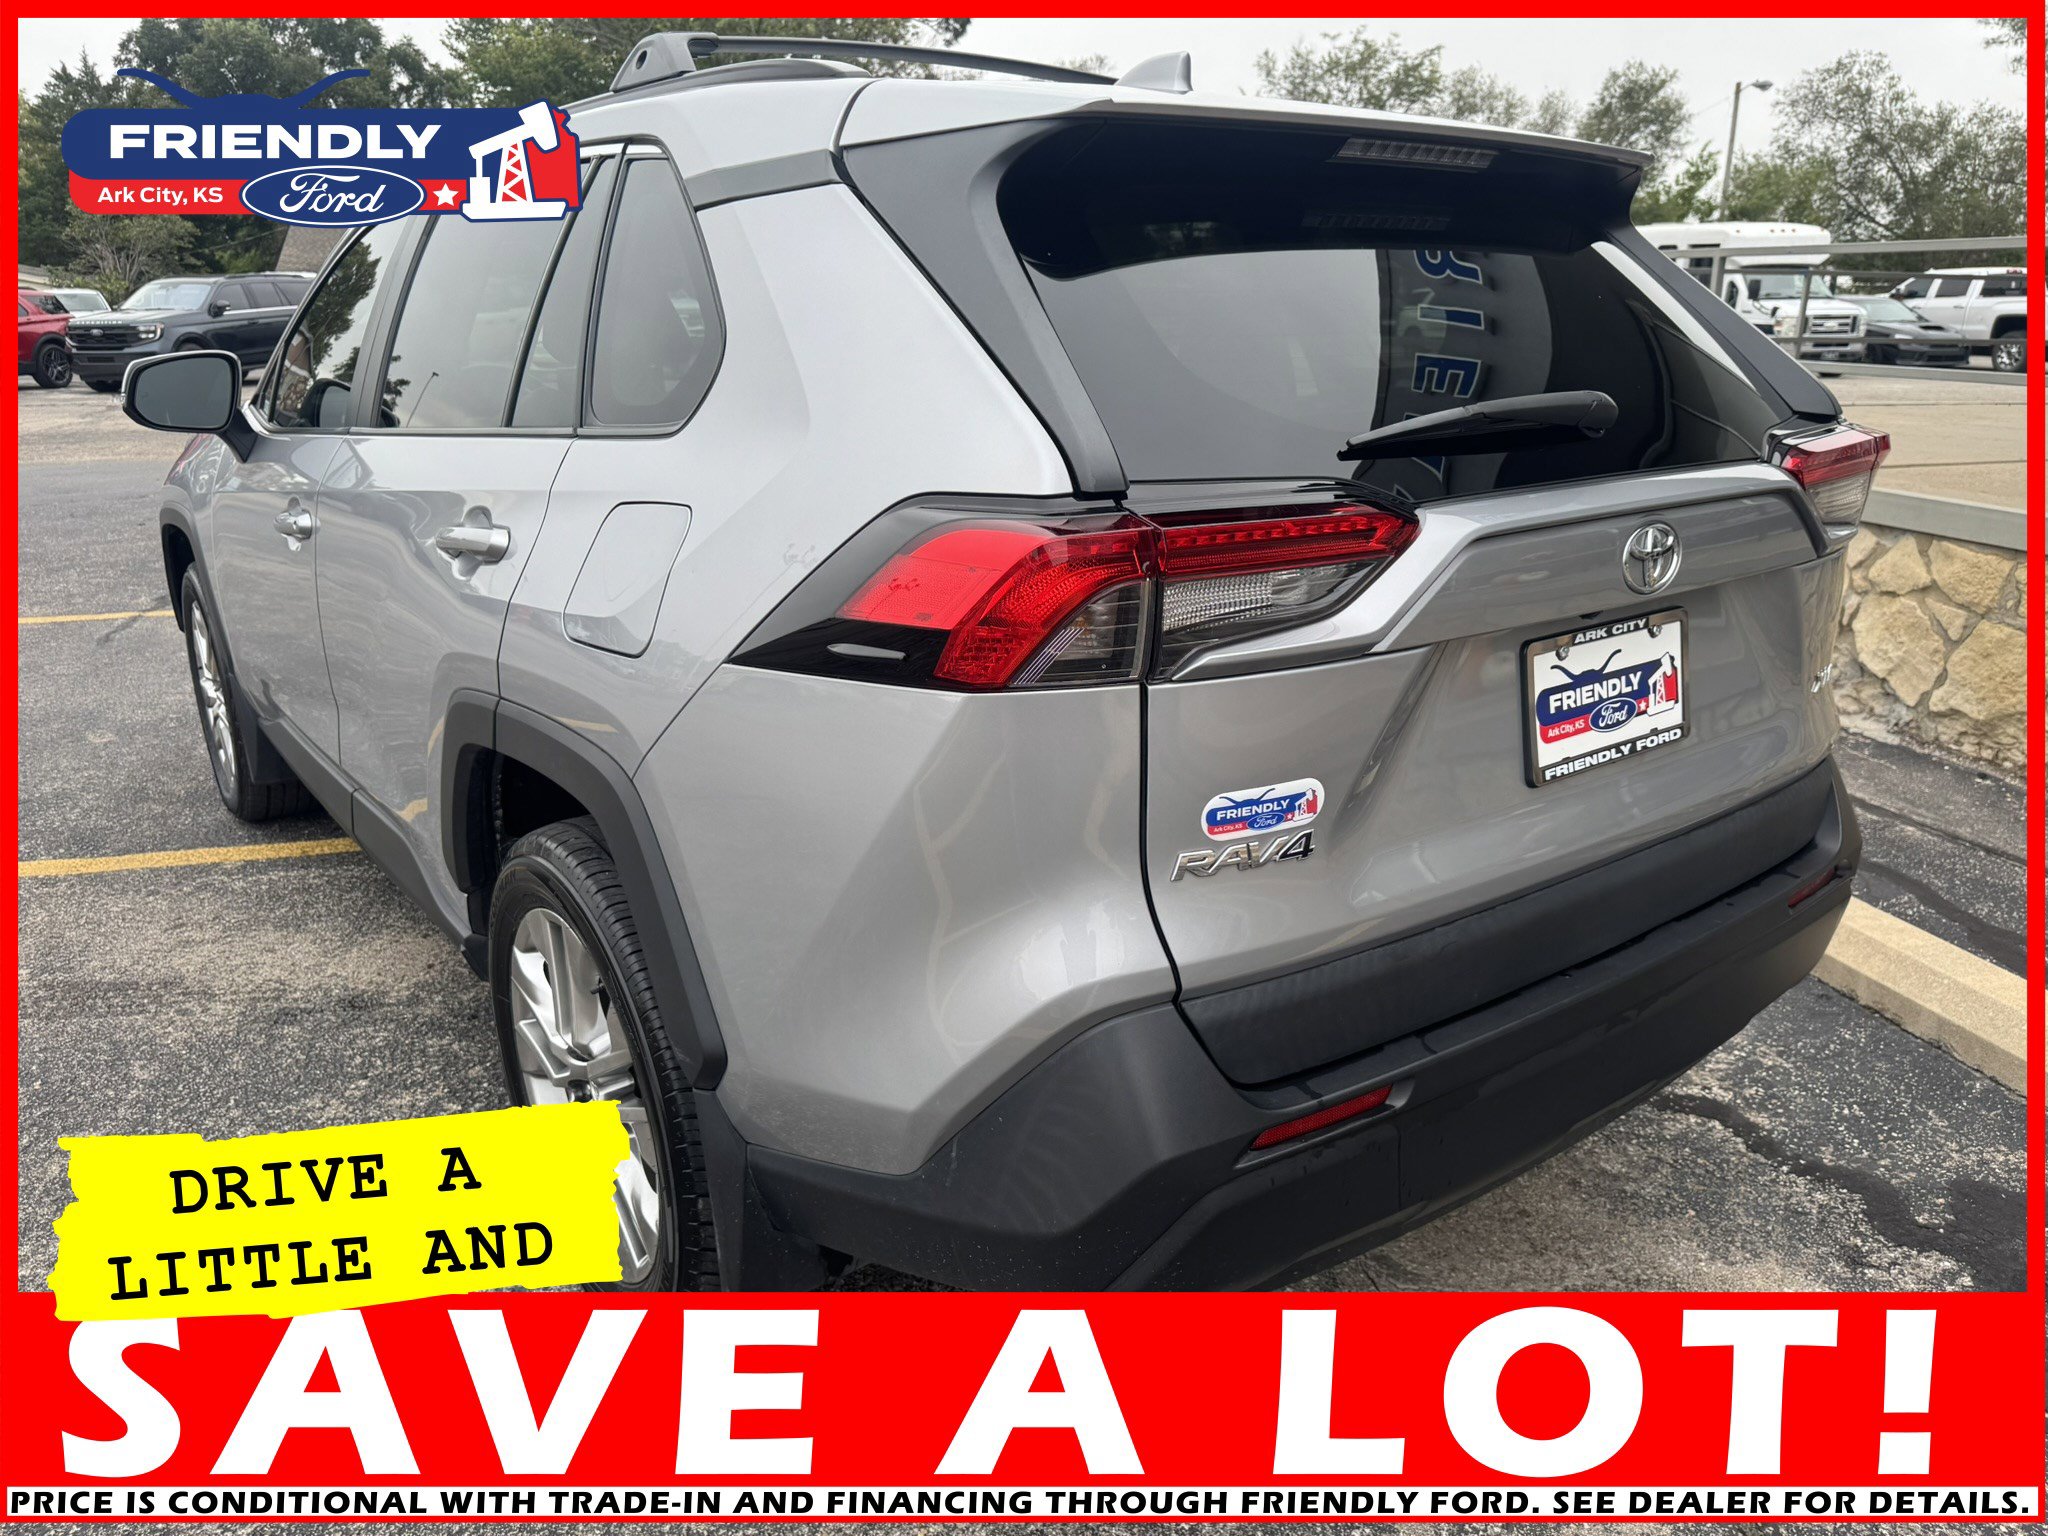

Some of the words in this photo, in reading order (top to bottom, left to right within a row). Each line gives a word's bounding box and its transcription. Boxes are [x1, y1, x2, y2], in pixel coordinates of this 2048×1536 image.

[1574, 628, 1607, 644] ARK
[1612, 618, 1647, 635] CITY
[1549, 671, 1642, 714] FRIENDLY
[1599, 702, 1628, 727] Ford
[1548, 728, 1560, 738] Ark
[1575, 719, 1585, 729] KS
[1544, 743, 1632, 781] FRIENDLY
[1636, 728, 1682, 751] FORD
[1216, 799, 1290, 821] FRIENDLY
[1253, 813, 1278, 828] Ford
[1170, 829, 1315, 882] RAV4
